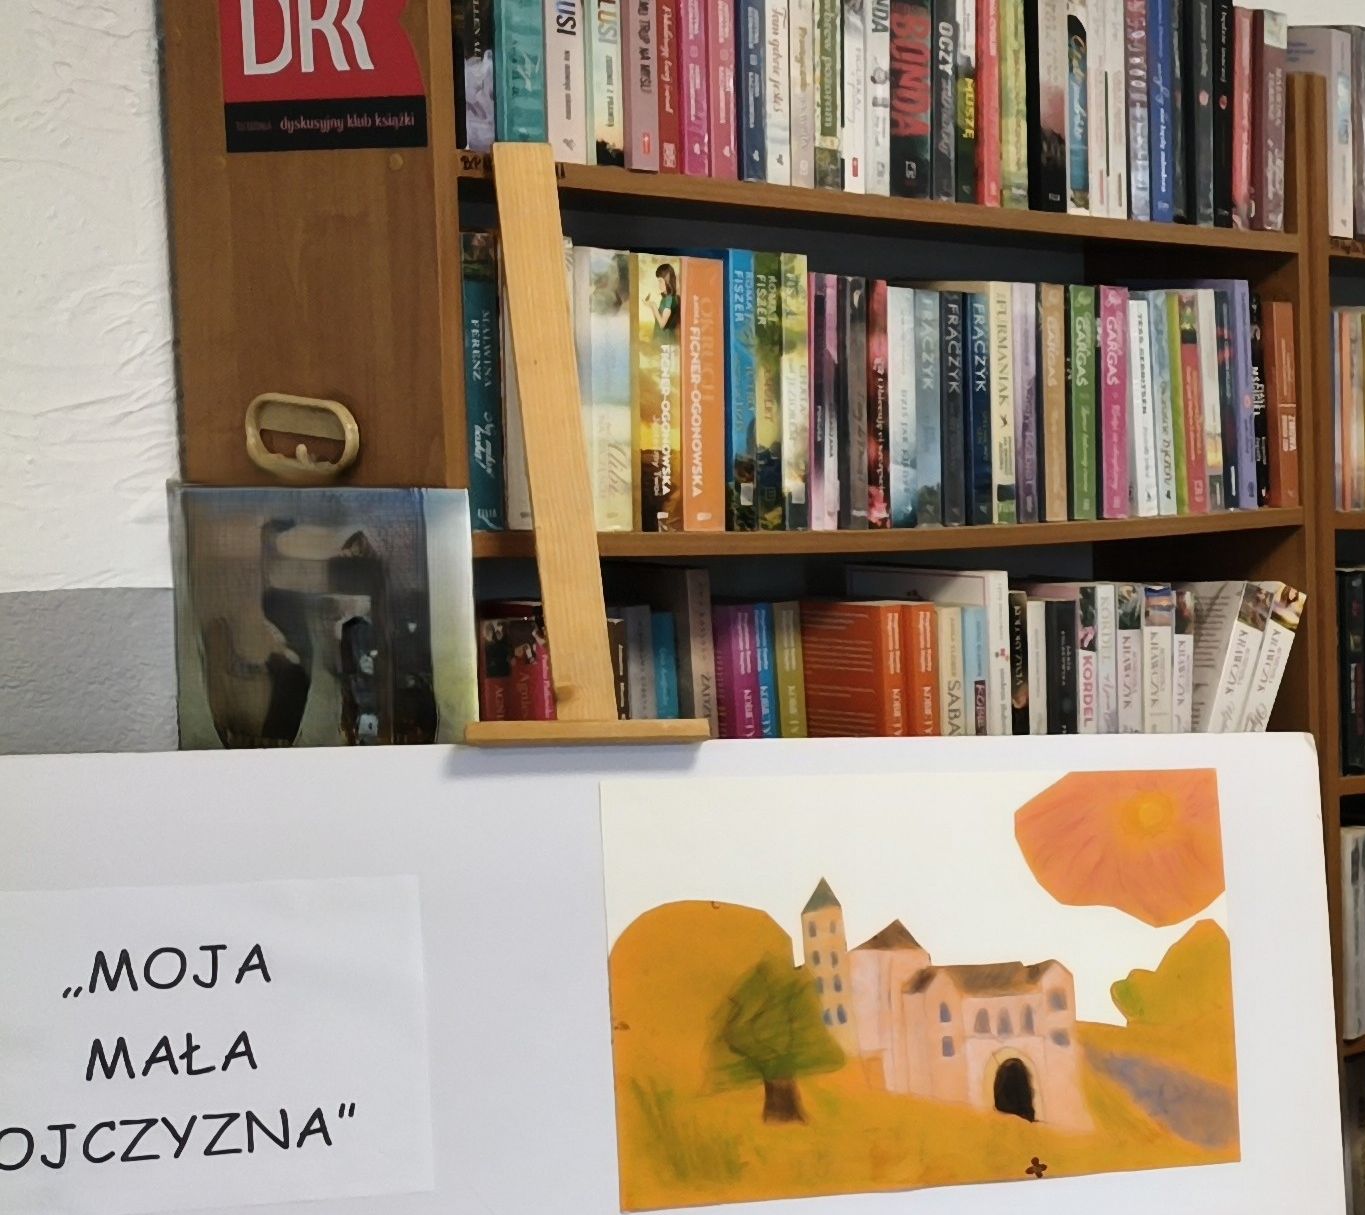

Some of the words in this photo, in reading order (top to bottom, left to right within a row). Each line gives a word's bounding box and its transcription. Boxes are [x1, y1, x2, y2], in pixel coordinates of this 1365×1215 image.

[938, 22, 954, 76] OCZY
[280, 114, 344, 134] dyskusyjny
[347, 113, 372, 128] klub
[375, 112, 414, 130] książki
[734, 270, 744, 323] FISZER
[757, 274, 767, 326] FISZER
[470, 319, 482, 381] FERENZ
[921, 298, 934, 390] FRĄCZYK
[947, 303, 960, 394] FRĄCZYK
[973, 303, 987, 392] FRĄCZYK
[1075, 316, 1088, 387] GARGAŚ
[1106, 316, 1118, 387] GARGAŚ
[660, 345, 671, 496] FICNER-OGONOWSKA
[690, 327, 703, 498] FICNER-OGONOWSKA
[1099, 596, 1110, 664] KORDEL
[1083, 655, 1094, 726] KORDEL
[62, 943, 271, 998] „MOJA
[86, 1030, 258, 1081] MAŁA
